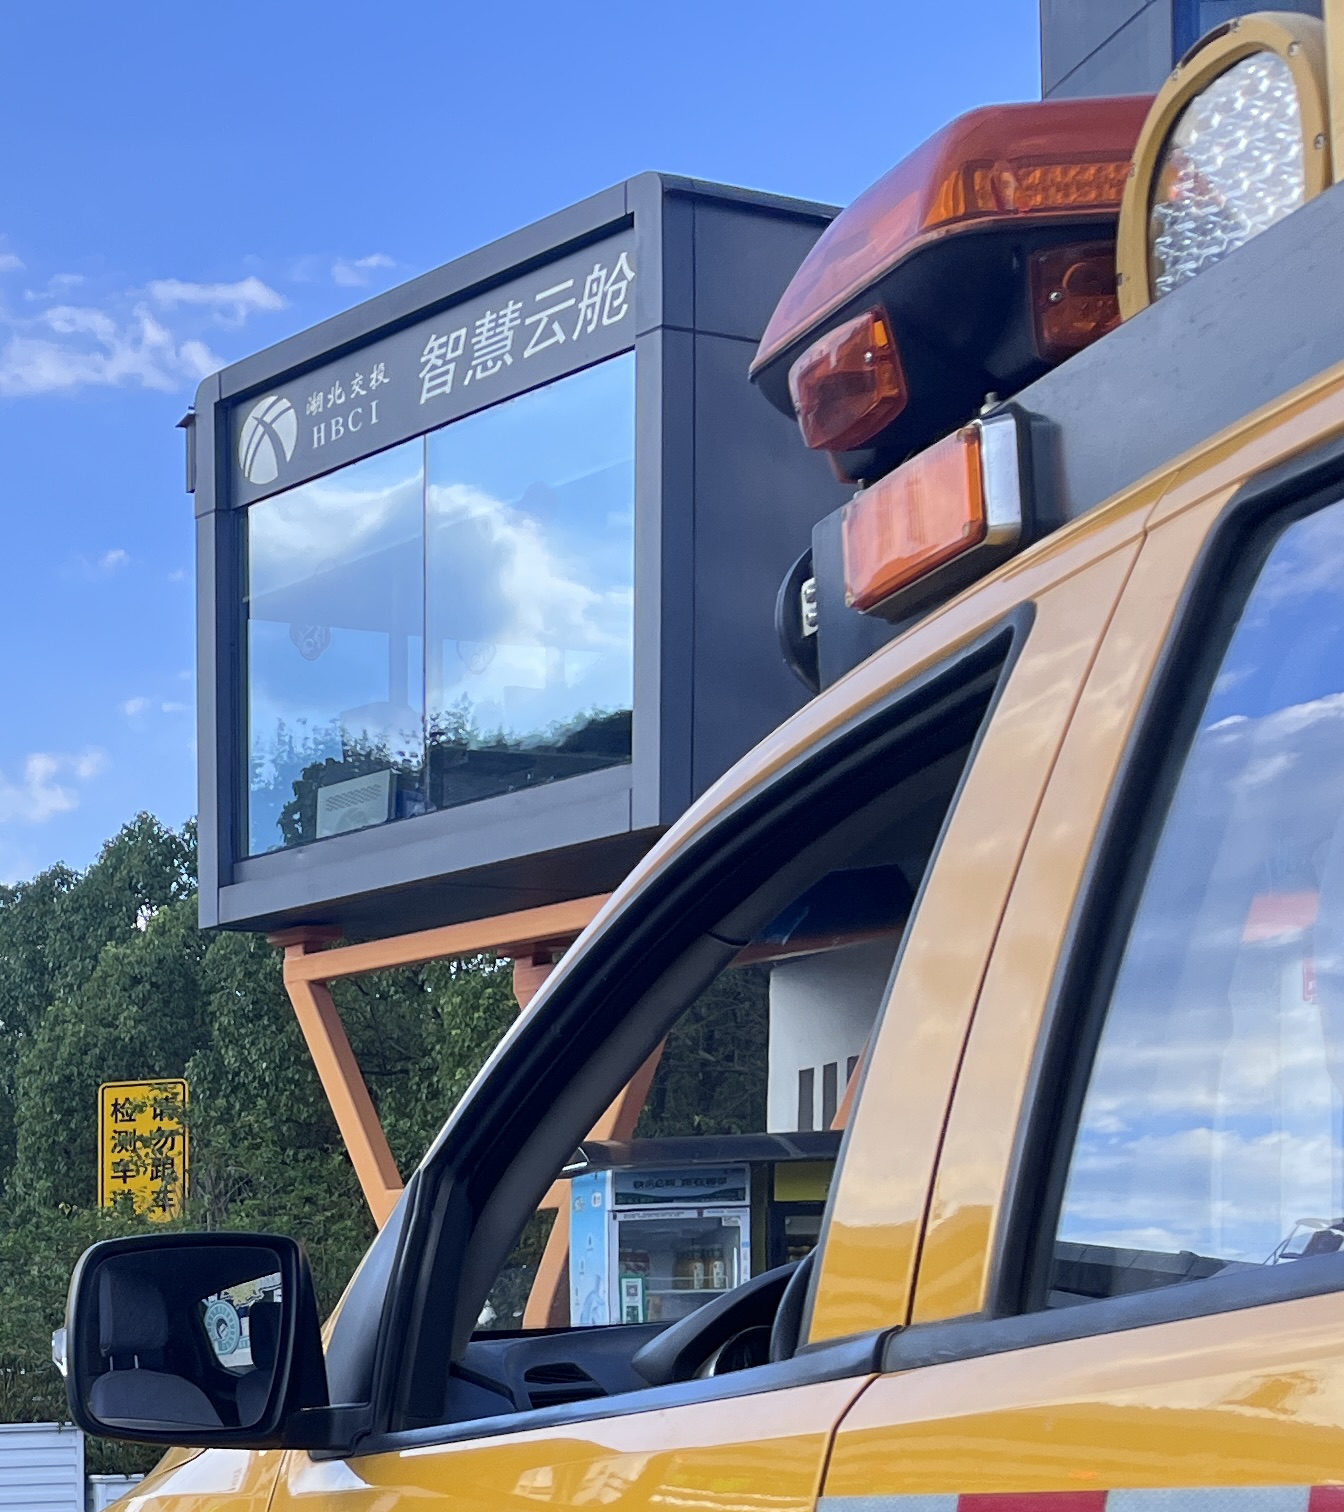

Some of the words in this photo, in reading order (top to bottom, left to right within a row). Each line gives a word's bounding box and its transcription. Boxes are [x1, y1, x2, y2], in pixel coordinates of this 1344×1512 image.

[417, 252, 635, 405] 智慧云舱
[305, 361, 391, 417] 湖北交投
[311, 400, 382, 449] HBCI
[110, 1097, 136, 1208] 检测车
